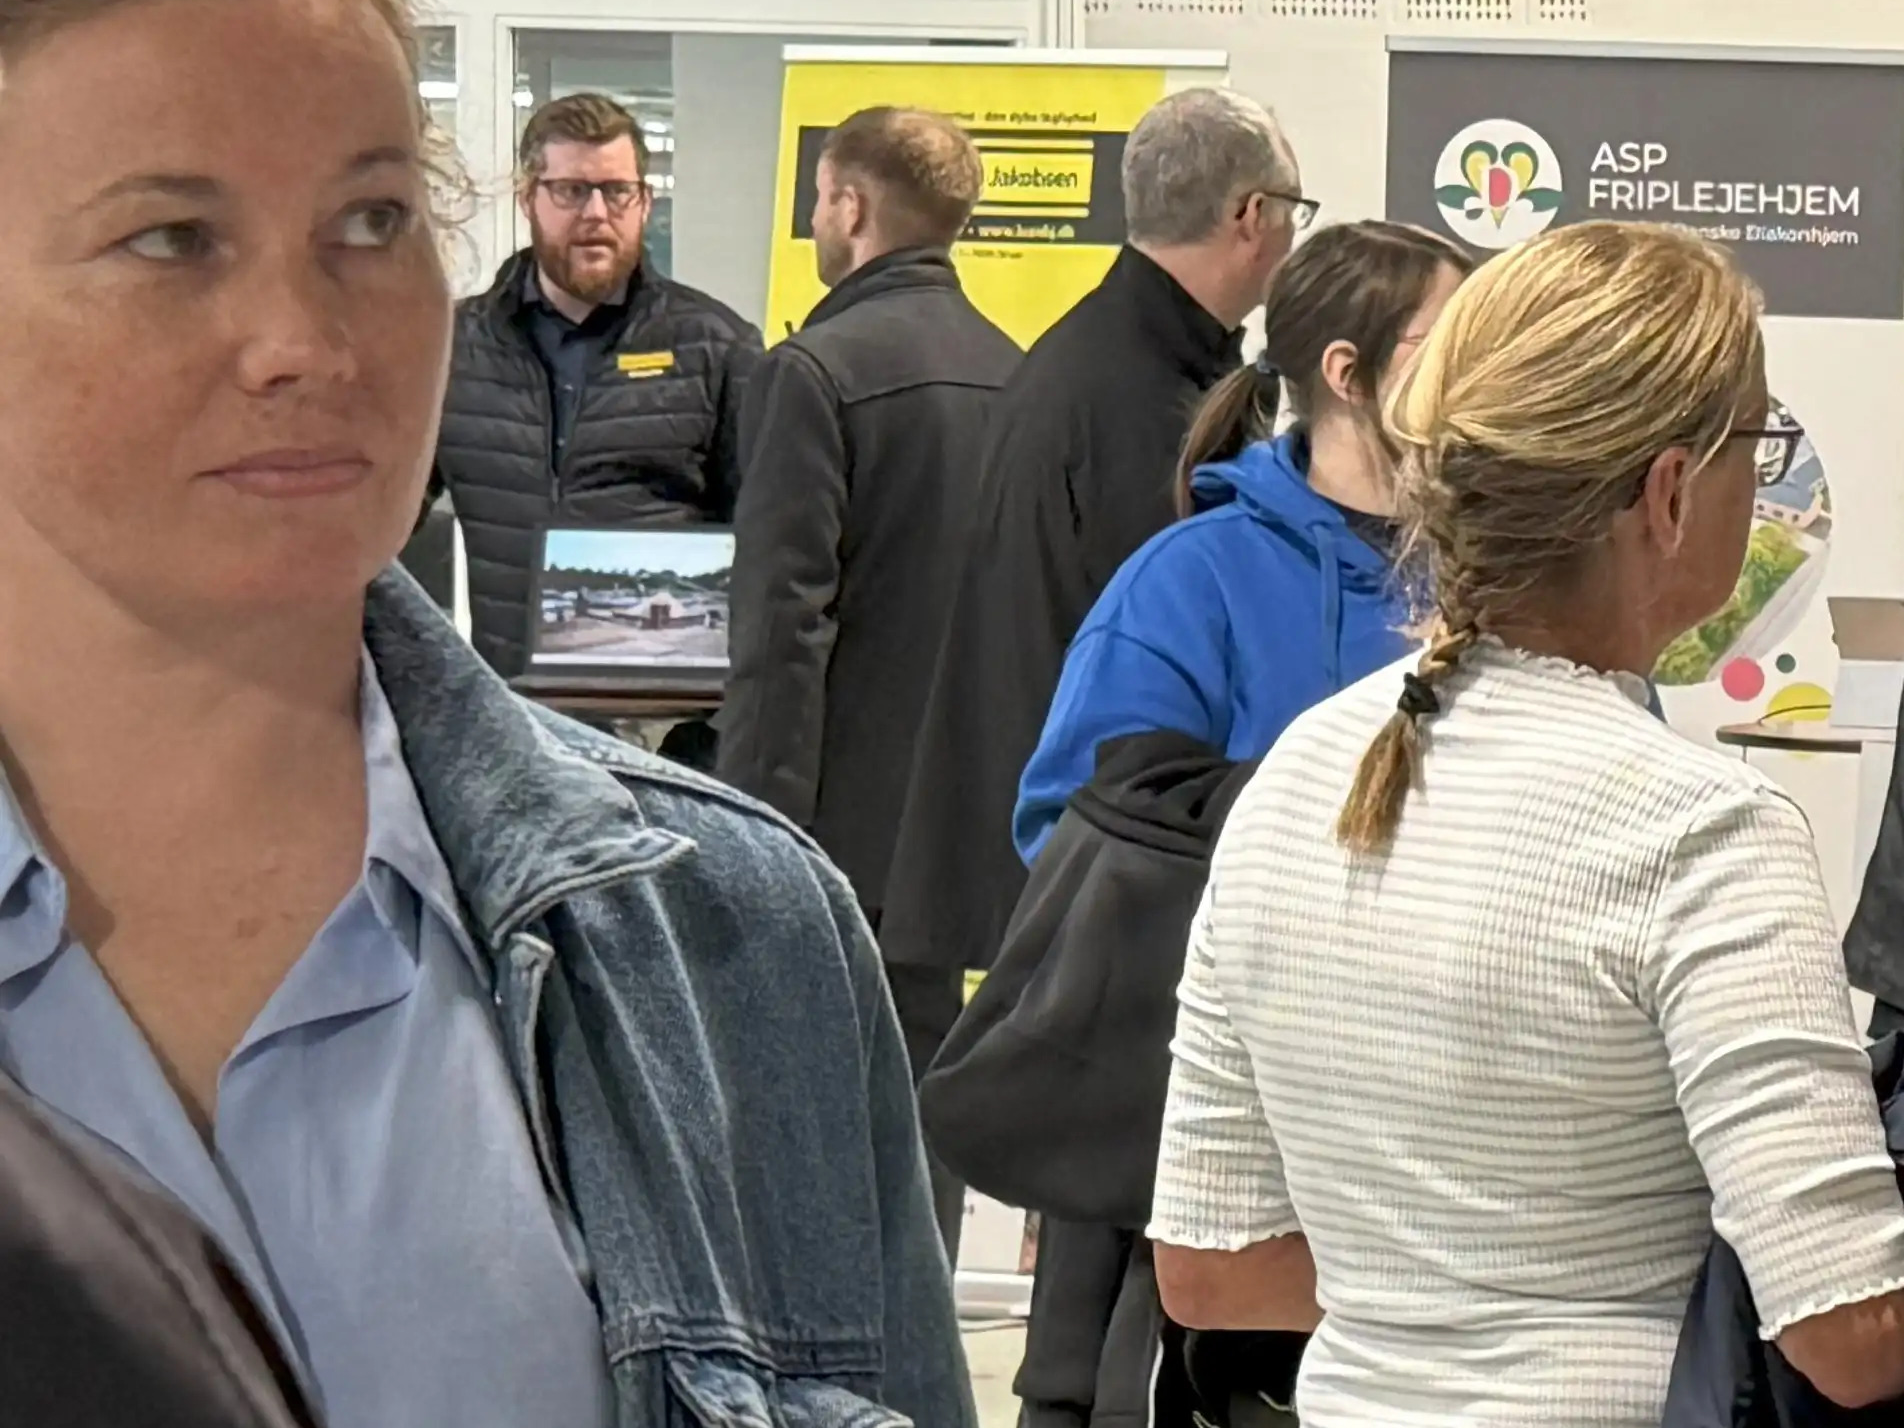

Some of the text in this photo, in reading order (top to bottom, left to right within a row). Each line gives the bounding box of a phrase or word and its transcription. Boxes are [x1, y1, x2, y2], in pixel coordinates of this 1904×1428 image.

[1590, 141, 1667, 174] ASP
[988, 165, 1078, 188] Jakobsen
[1588, 178, 1860, 217] FRIPLEJEHJEM
